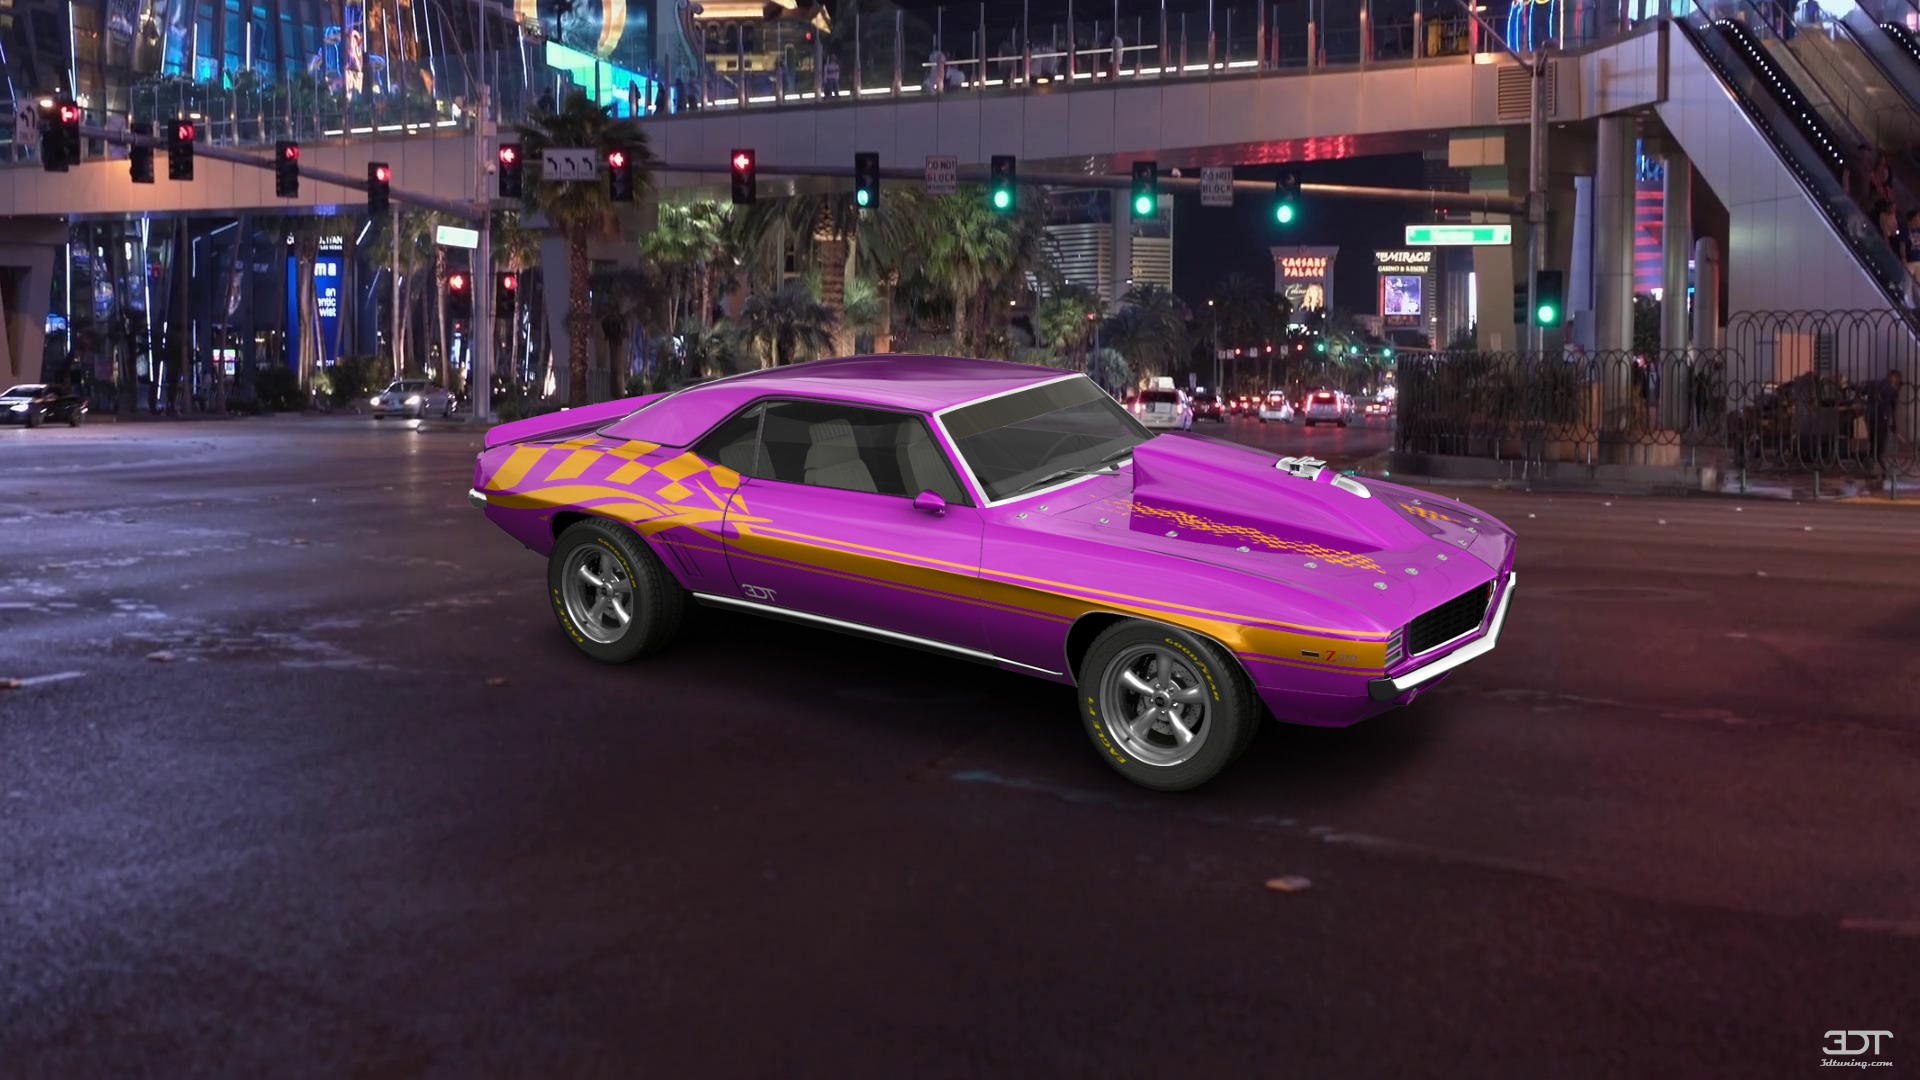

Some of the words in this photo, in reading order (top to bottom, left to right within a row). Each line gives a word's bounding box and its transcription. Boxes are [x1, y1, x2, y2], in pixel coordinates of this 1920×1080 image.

[1282, 257, 1327, 267] CAESARS
[1385, 252, 1431, 263] MIRAGE
[1284, 267, 1325, 277] PALACE
[1164, 637, 1219, 701] GOODYEAR
[1092, 720, 1127, 763] EAGLE
